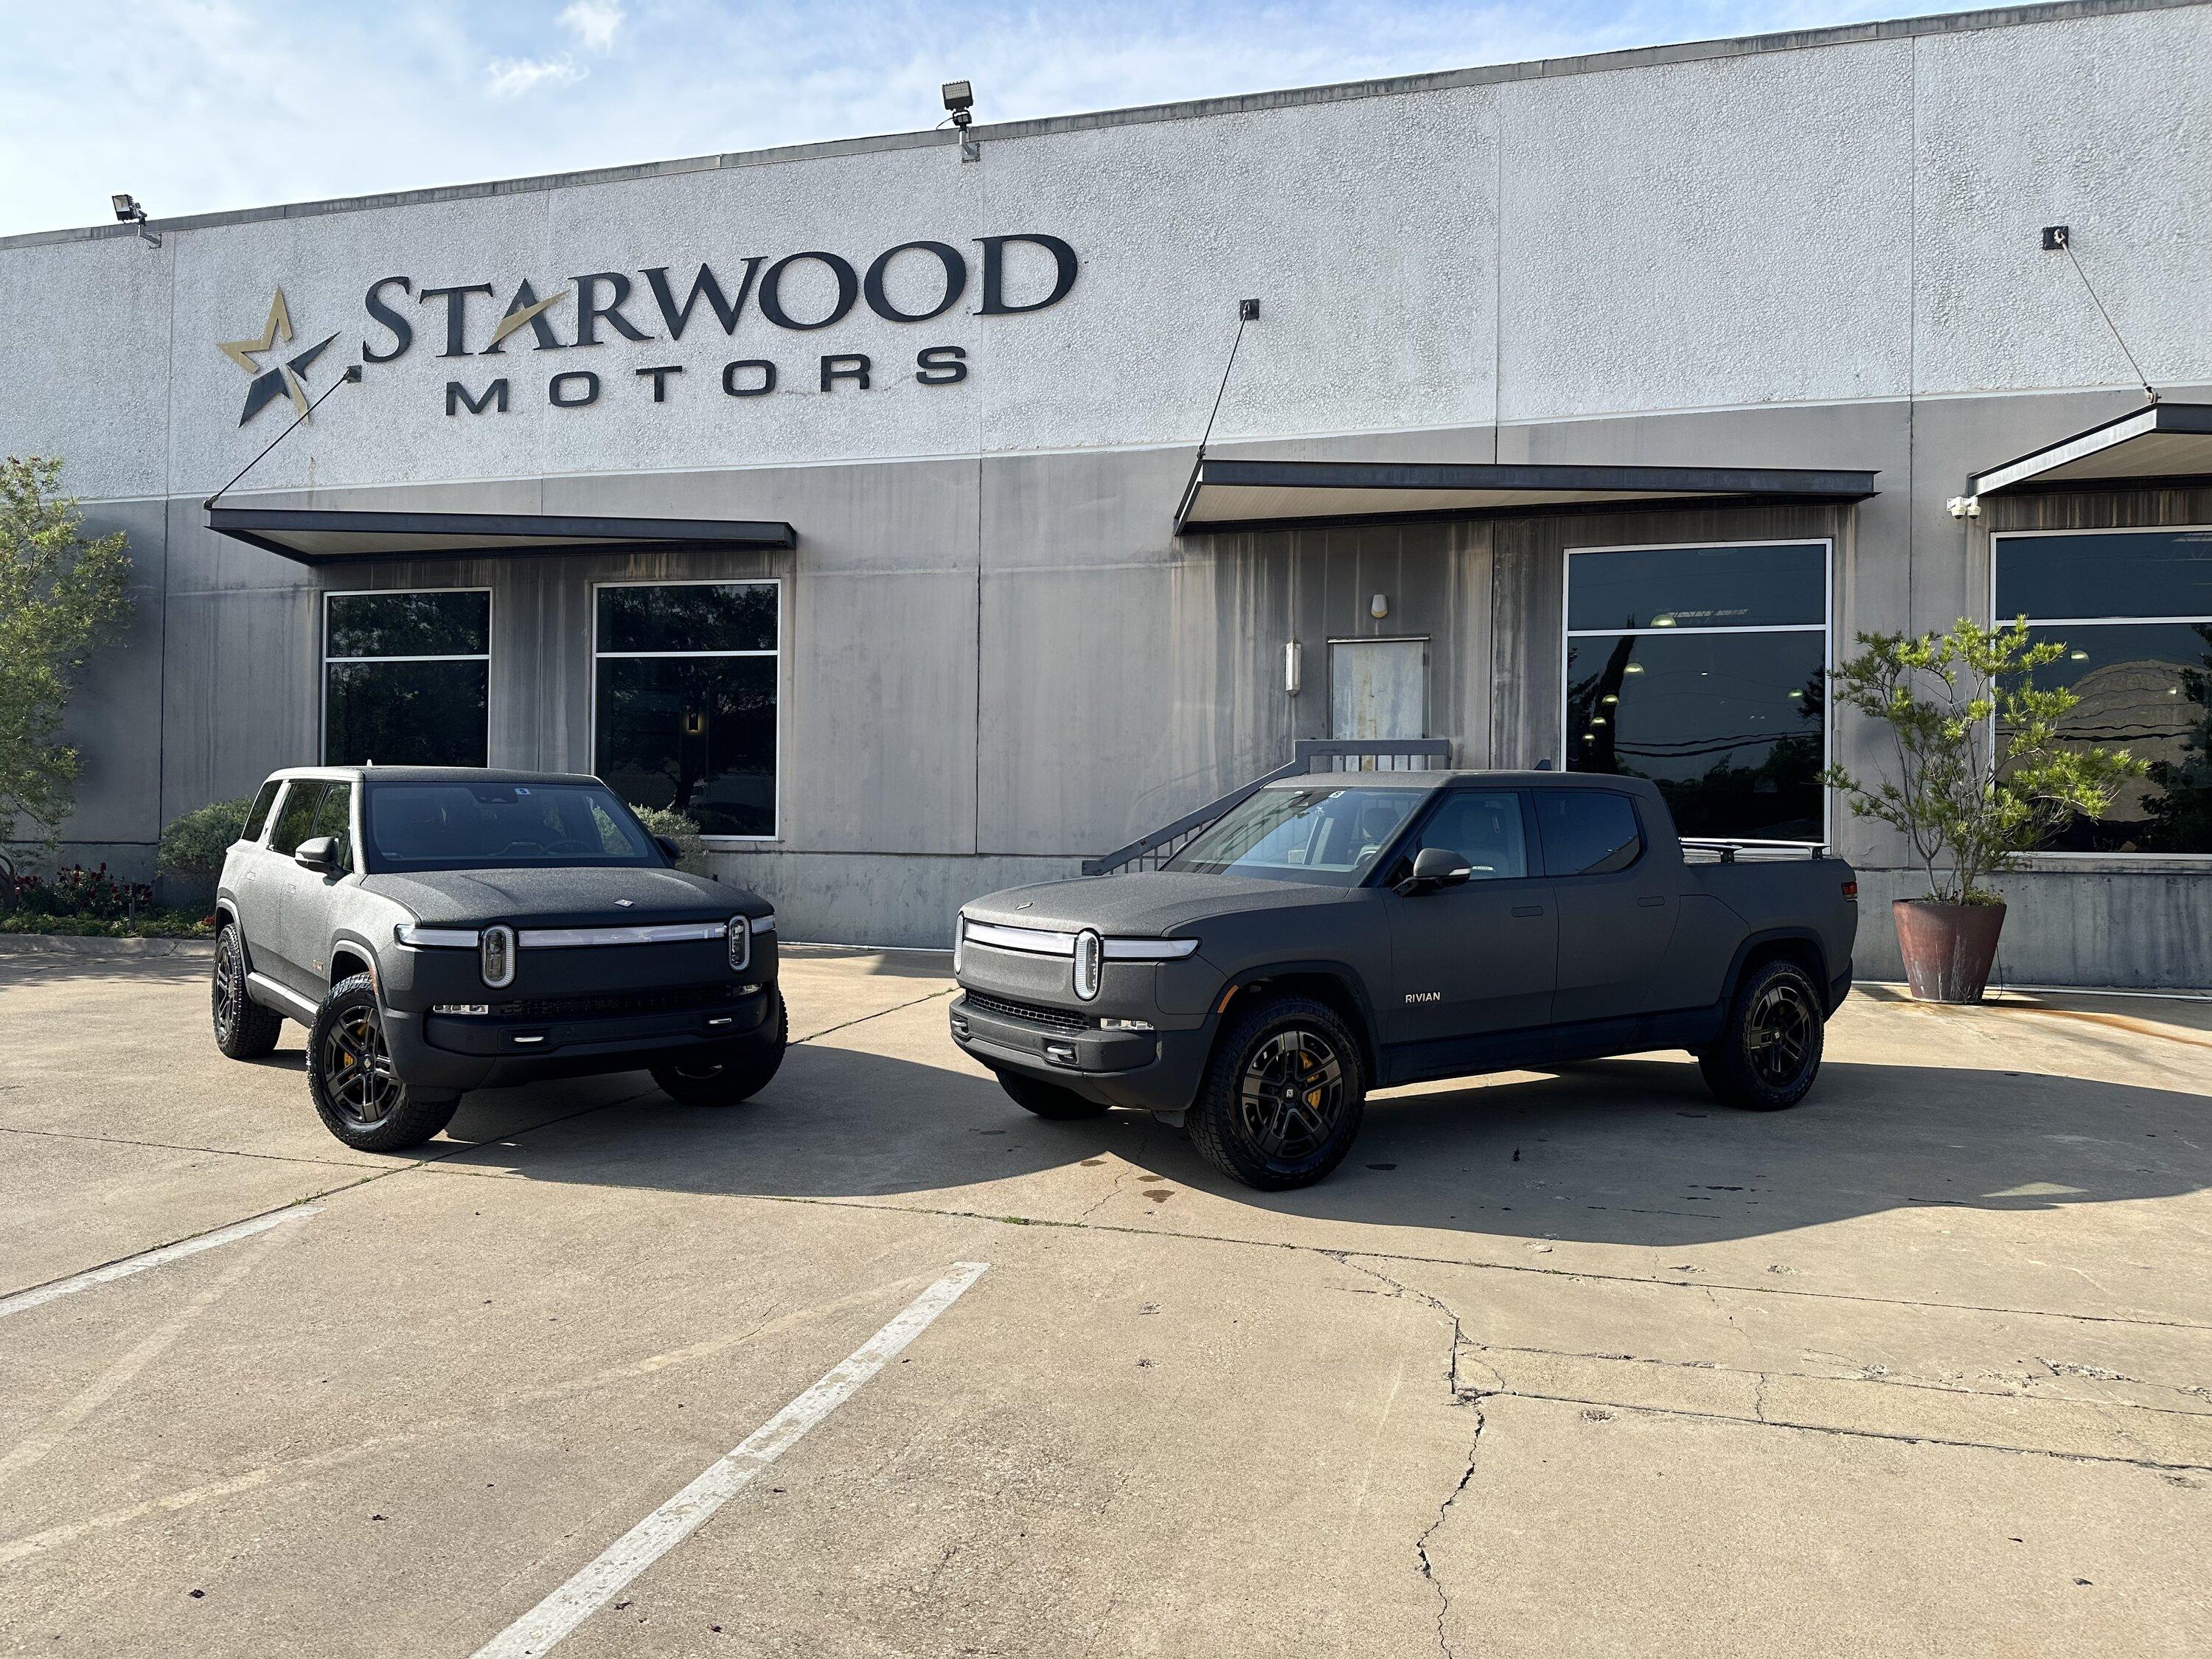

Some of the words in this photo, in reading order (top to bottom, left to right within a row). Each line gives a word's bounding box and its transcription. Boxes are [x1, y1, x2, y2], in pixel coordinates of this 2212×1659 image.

[362, 233, 1079, 364] STARWOOD
[445, 346, 967, 417] MOTORS
[1405, 992, 1441, 1004] RIVIAN
